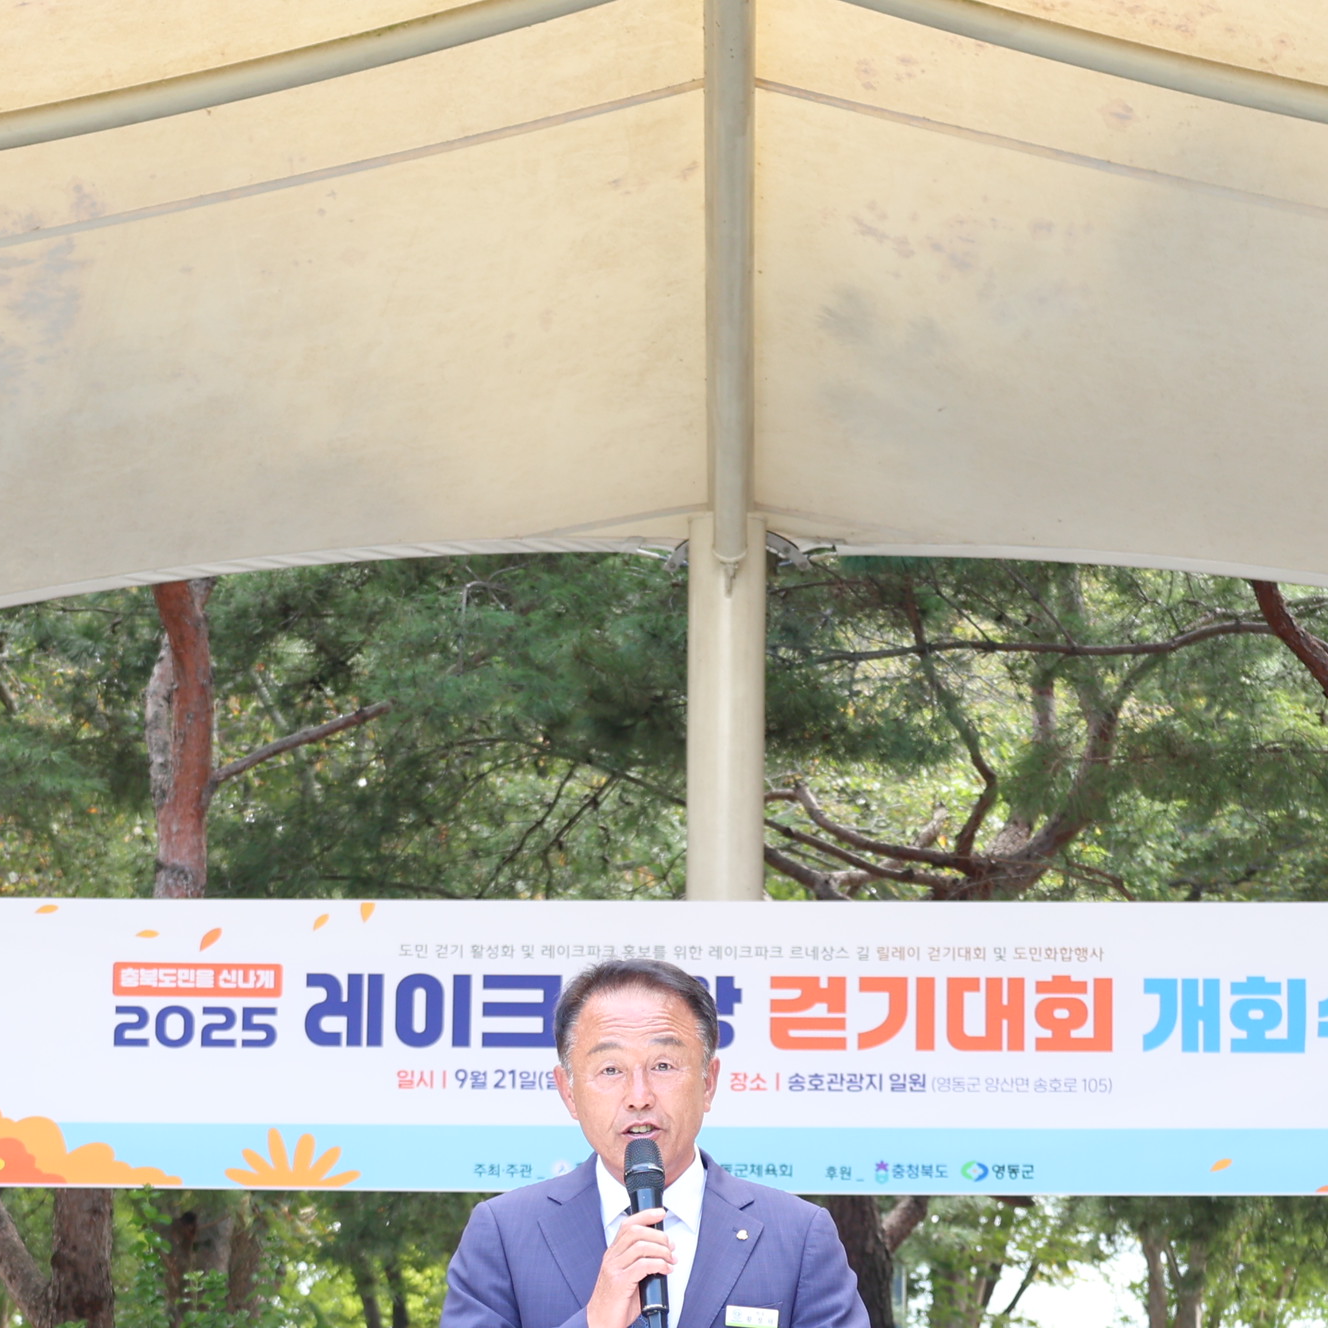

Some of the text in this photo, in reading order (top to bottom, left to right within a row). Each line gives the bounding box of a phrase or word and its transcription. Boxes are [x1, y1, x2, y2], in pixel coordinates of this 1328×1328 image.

[399, 944, 428, 959] 도민
[436, 944, 463, 959] 걷기
[471, 944, 515, 959] 활성화
[521, 945, 534, 959] 및
[623, 945, 668, 959] 홍보를
[674, 945, 703, 960] 위한
[708, 945, 784, 960] 레이크파크
[789, 946, 849, 961] 르네상스
[857, 946, 869, 961] 길
[877, 946, 920, 961] 릴레이
[928, 946, 986, 961] 걷기대회
[993, 947, 1006, 961] 및
[120, 967, 276, 989] 충북도민을 신나게
[114, 1005, 277, 1048] 2025
[769, 975, 1113, 1052] 걷기대회
[397, 1070, 434, 1089] 일시
[455, 1069, 487, 1089] 9월
[730, 1072, 1112, 1094] 장소 송호관광지 일원 (영동군 양산면 송호로 105)
[826, 1166, 851, 1180] 후원
[892, 1164, 948, 1179] 충청북도
[992, 1165, 1034, 1180] 영동군
